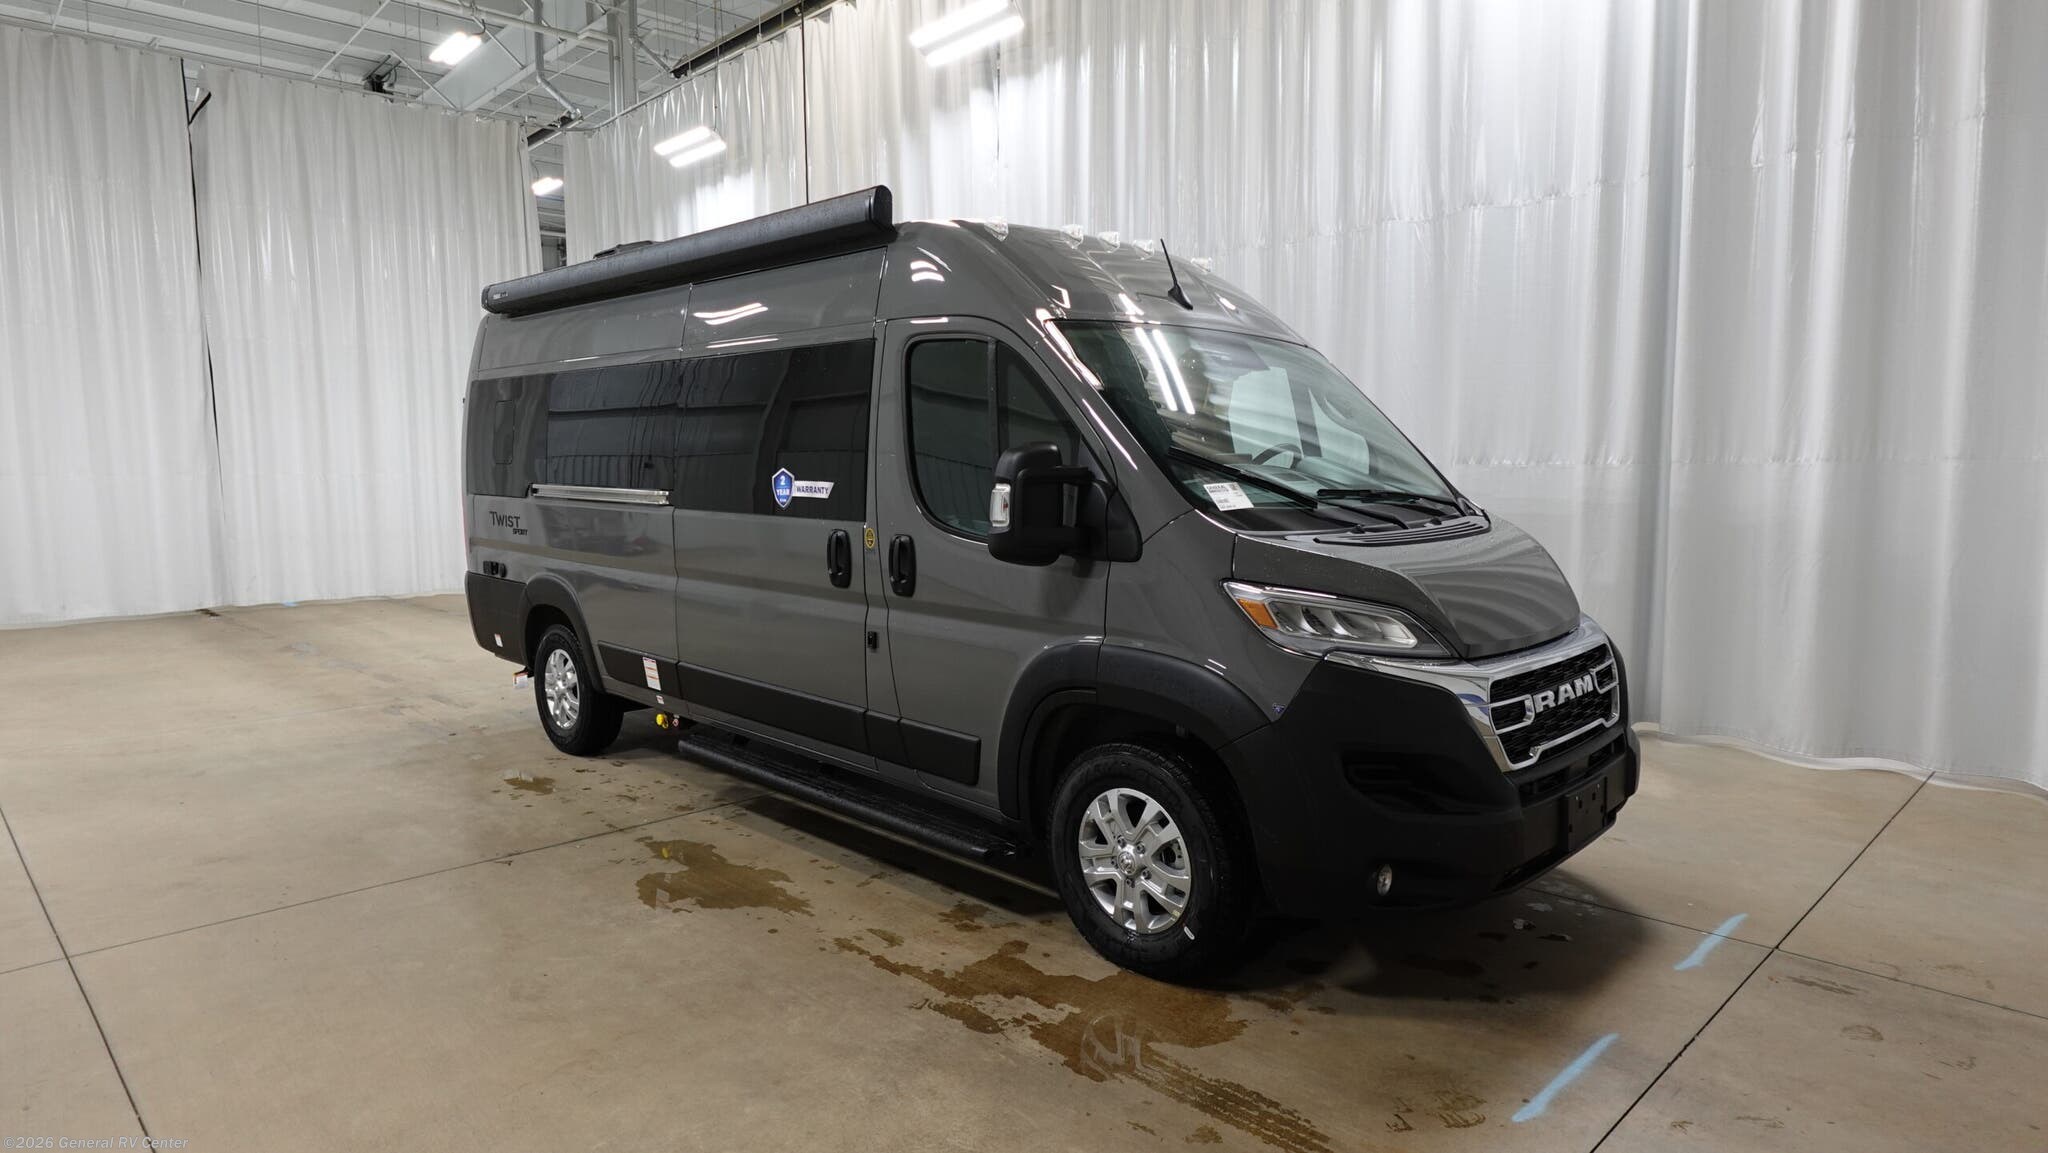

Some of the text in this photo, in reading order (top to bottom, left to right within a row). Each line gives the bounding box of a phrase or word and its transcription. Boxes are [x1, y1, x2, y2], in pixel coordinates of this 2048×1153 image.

[780, 475, 786, 486] 2
[796, 485, 829, 495] WARRANTY
[1533, 674, 1594, 713] RAM
